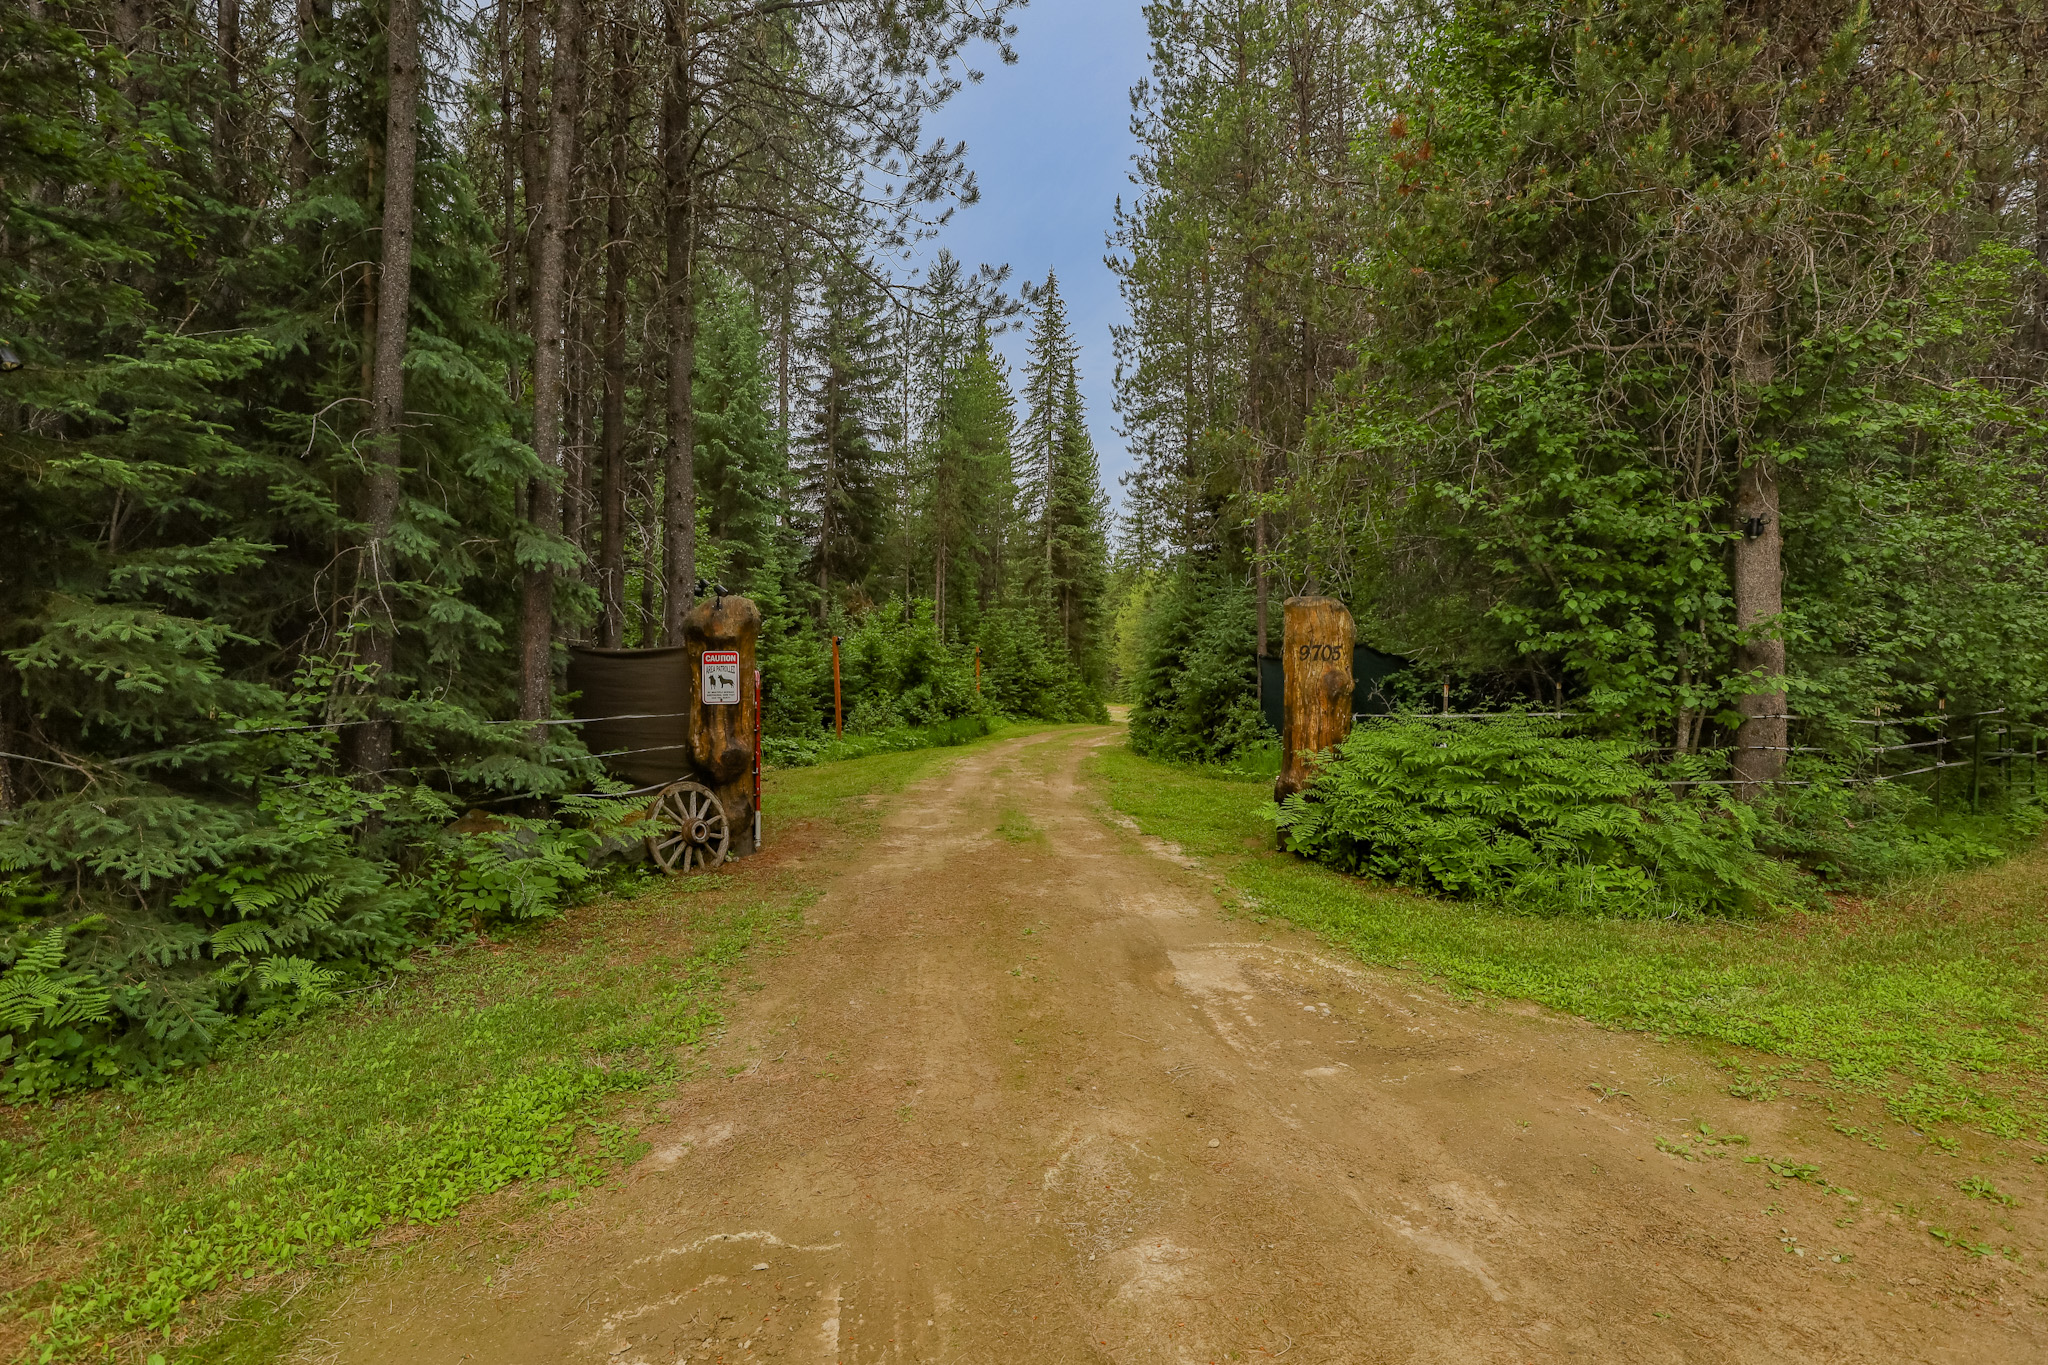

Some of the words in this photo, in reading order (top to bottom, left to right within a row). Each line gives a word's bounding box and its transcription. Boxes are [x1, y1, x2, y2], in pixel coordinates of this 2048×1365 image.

[1300, 644, 1342, 661] 9705
[705, 654, 736, 662] CAUTION
[706, 665, 715, 674] AREA
[716, 665, 735, 674] PATROLLED
